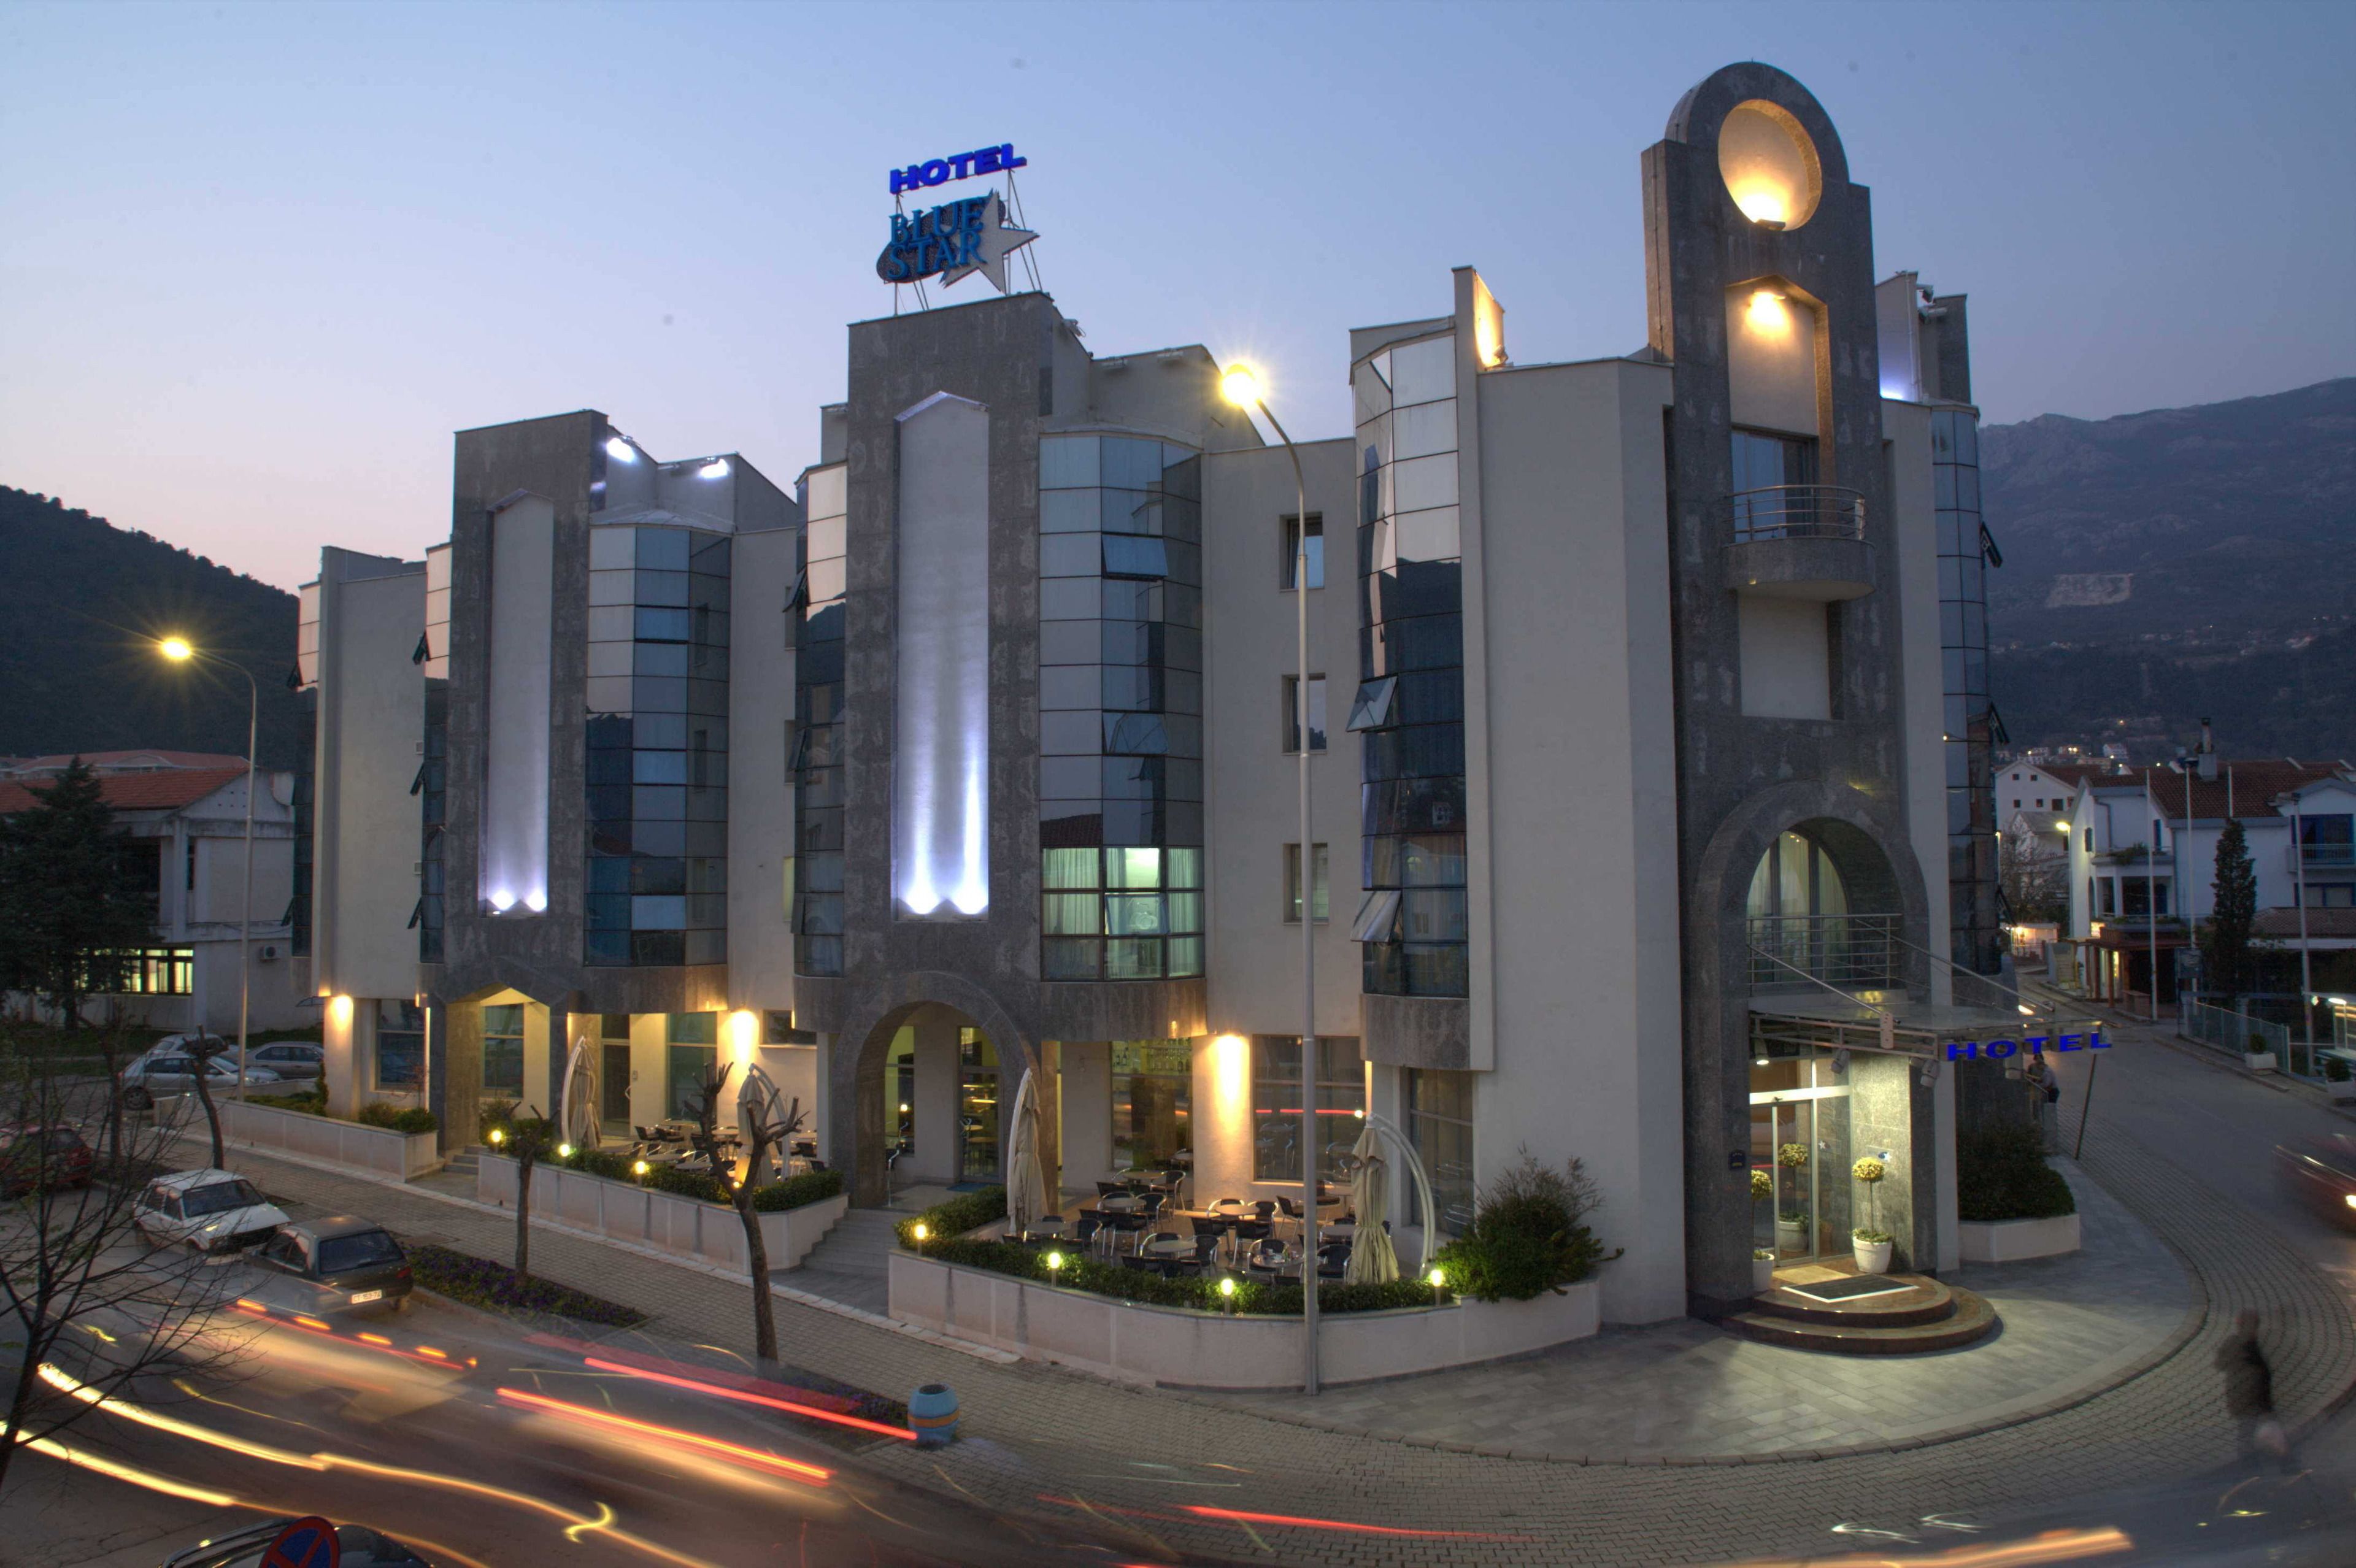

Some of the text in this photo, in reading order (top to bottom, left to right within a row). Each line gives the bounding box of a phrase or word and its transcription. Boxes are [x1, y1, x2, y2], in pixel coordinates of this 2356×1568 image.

[890, 143, 1027, 194] HOTEL
[889, 196, 987, 245] BLUE
[887, 230, 987, 279] STAR
[1947, 1032, 2112, 1061] HOTEL
